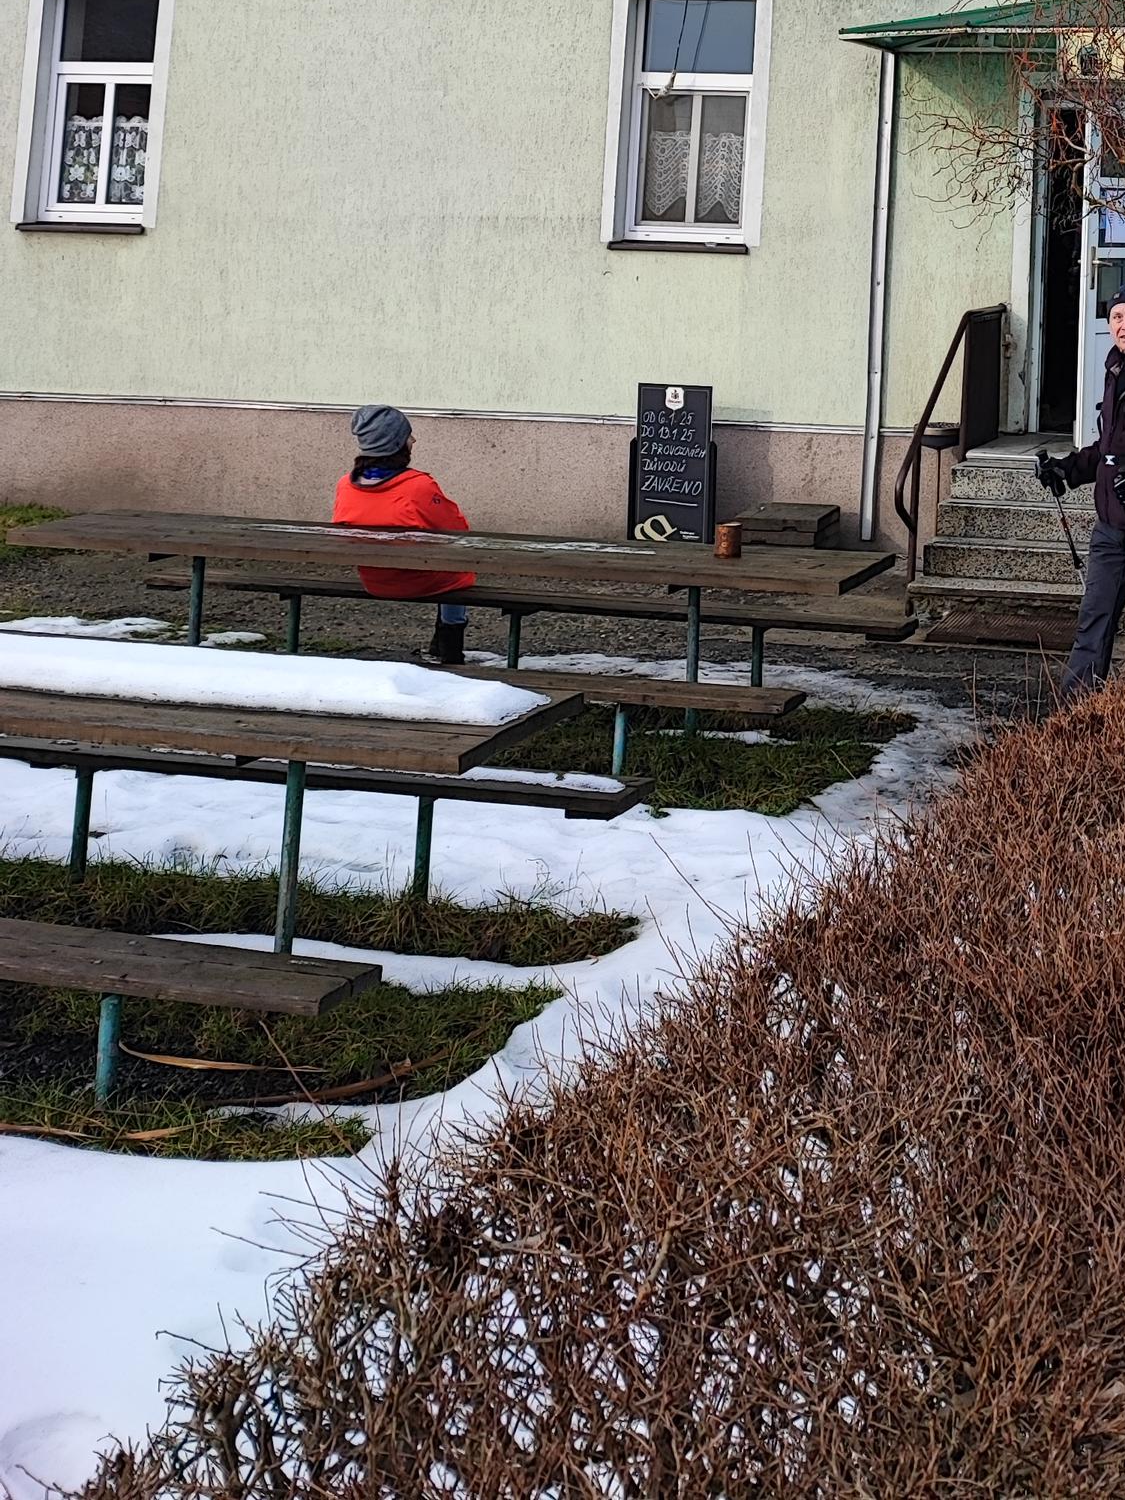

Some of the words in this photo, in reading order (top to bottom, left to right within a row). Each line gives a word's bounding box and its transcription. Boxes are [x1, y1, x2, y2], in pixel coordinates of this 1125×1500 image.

[643, 411, 656, 423] OD
[679, 411, 695, 425] 25
[641, 425, 655, 437] DO
[680, 428, 696, 442] 25
[640, 474, 702, 496] ZAVŘENO
